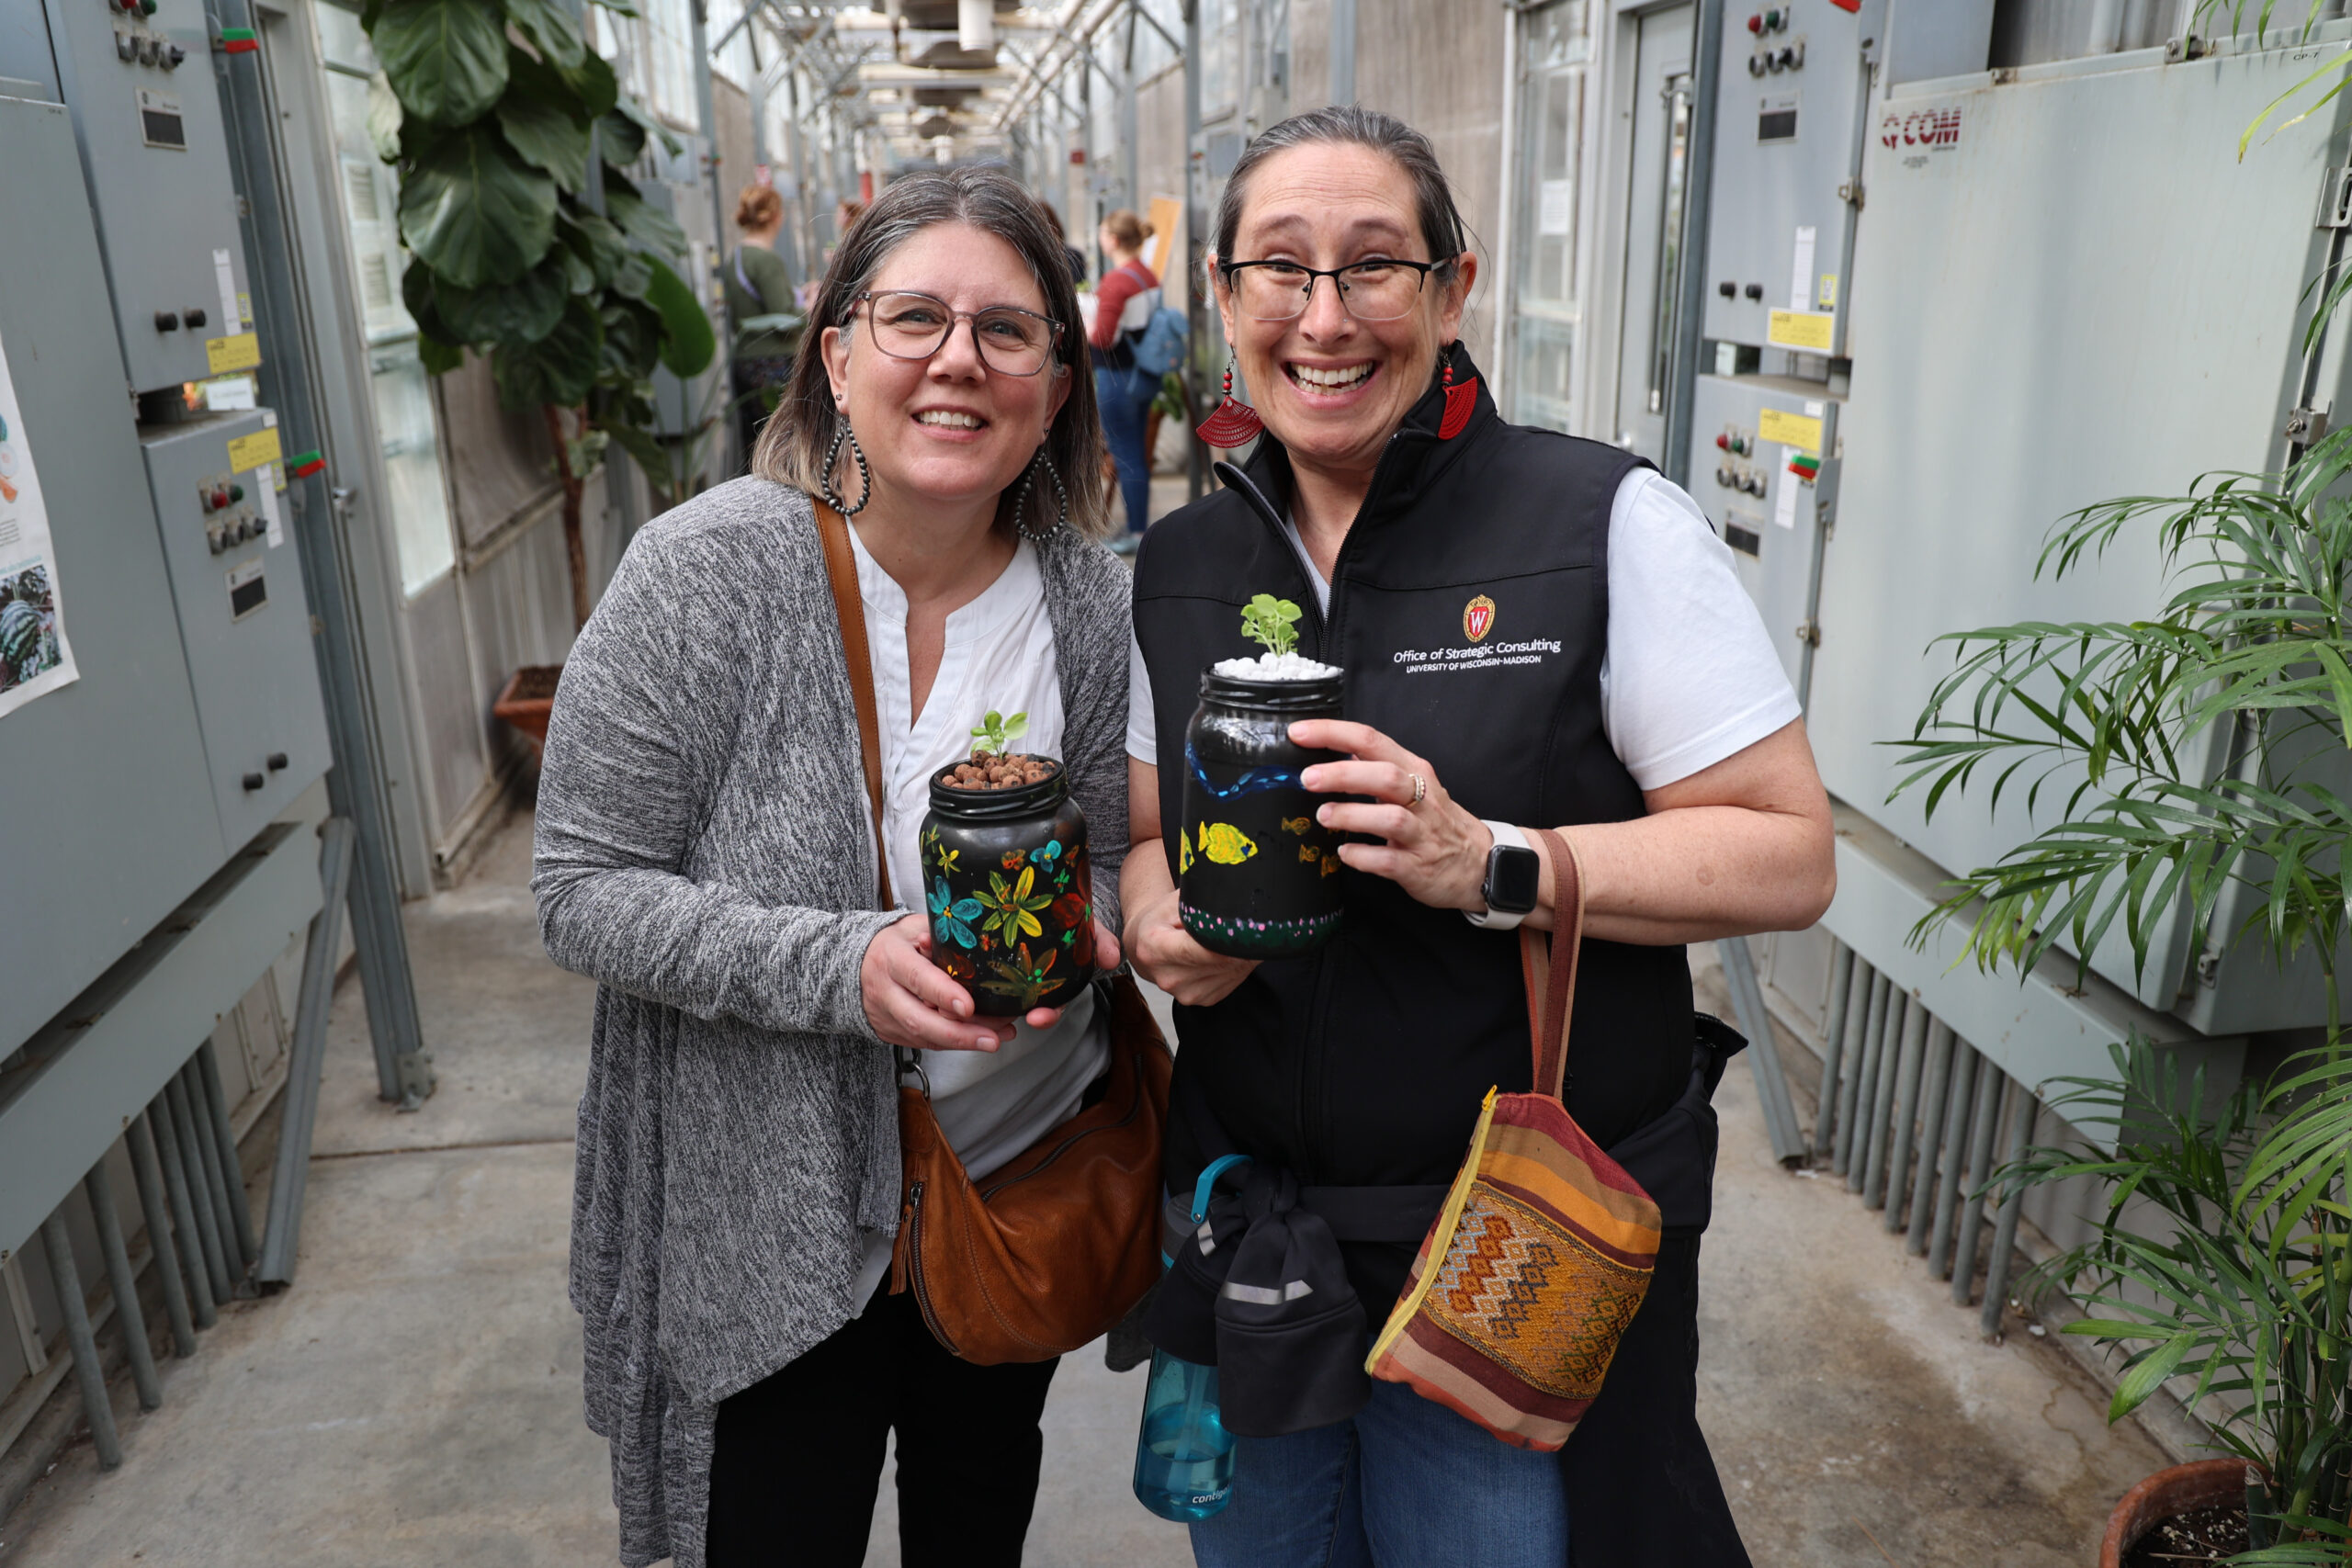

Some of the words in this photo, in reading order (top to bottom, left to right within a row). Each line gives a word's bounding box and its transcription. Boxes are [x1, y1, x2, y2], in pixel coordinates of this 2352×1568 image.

[1393, 649, 1427, 663] Office
[1430, 647, 1445, 660] of
[1446, 643, 1494, 659] Strategic
[1496, 637, 1562, 654] Consulting
[1406, 662, 1447, 674] UNIVERSITY
[1449, 661, 1460, 671] OF
[1460, 655, 1542, 670] WISCONSIN-MADISON
